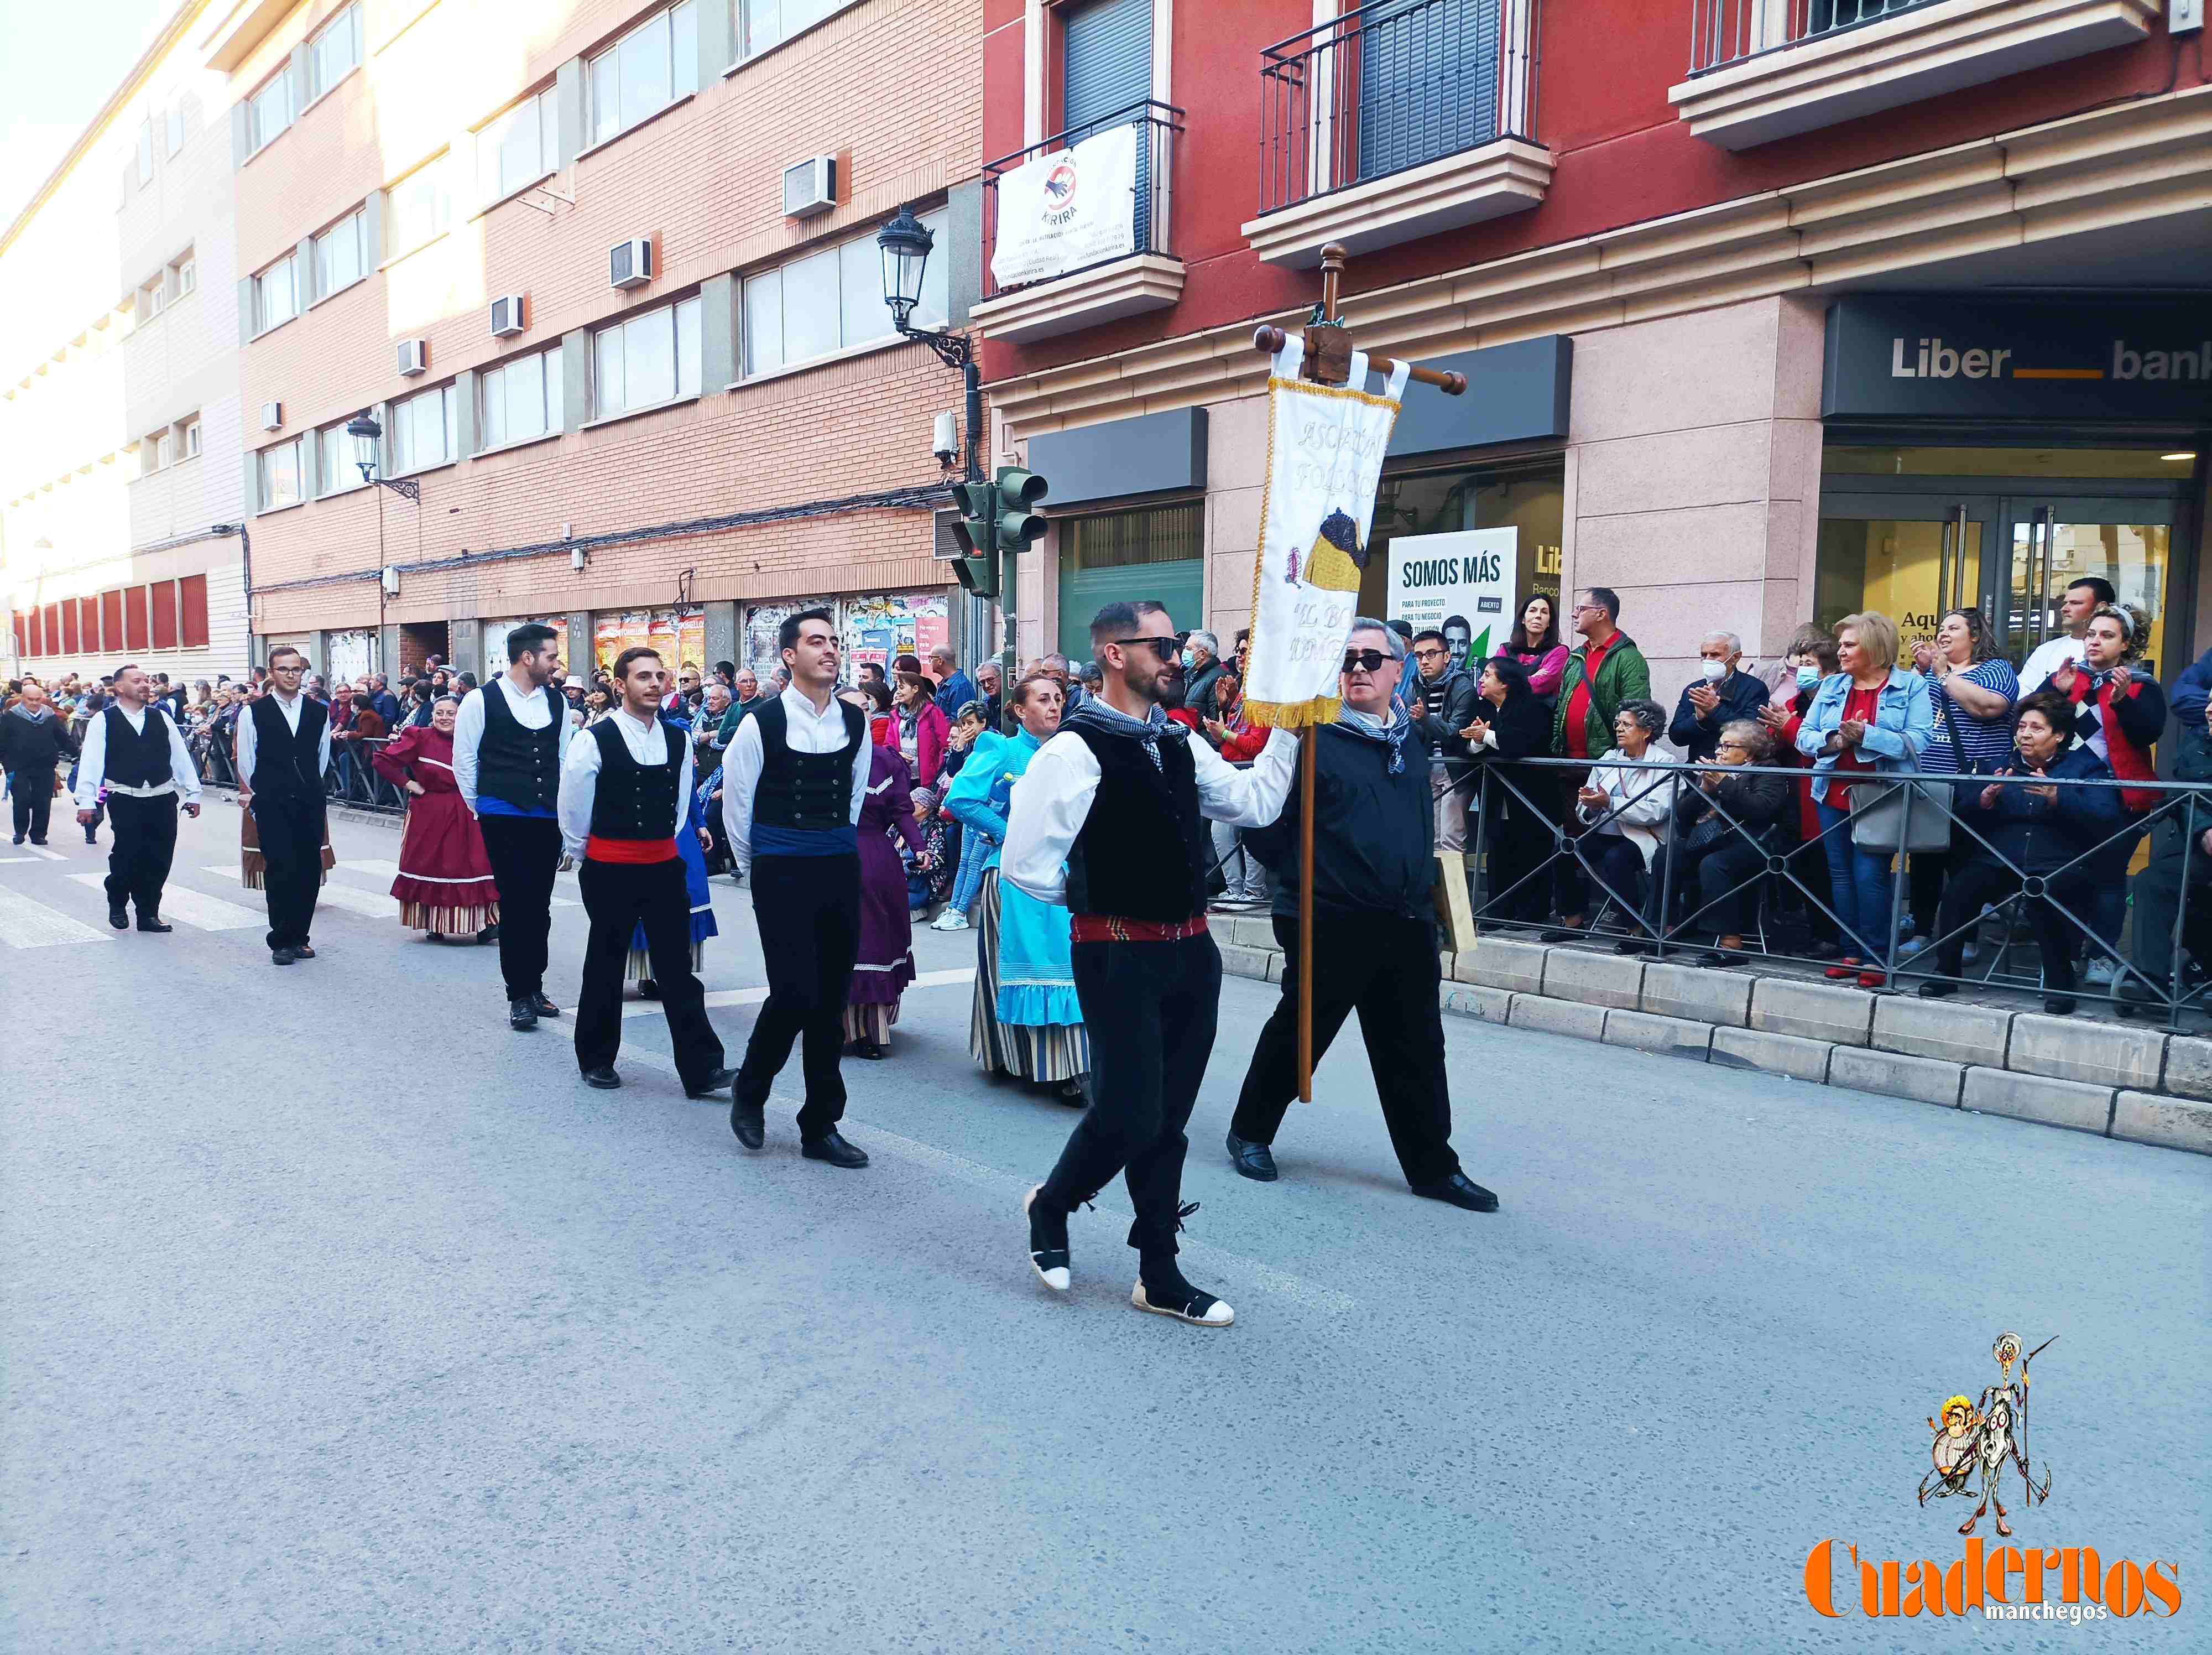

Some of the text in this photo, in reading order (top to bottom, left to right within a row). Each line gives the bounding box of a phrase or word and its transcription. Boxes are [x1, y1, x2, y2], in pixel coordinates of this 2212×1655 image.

[1041, 206, 1077, 225] KIRIRA
[1891, 338, 2012, 379] Liber
[1402, 550, 1500, 588] SOMOS MÁS
[1900, 634, 1908, 643] y
